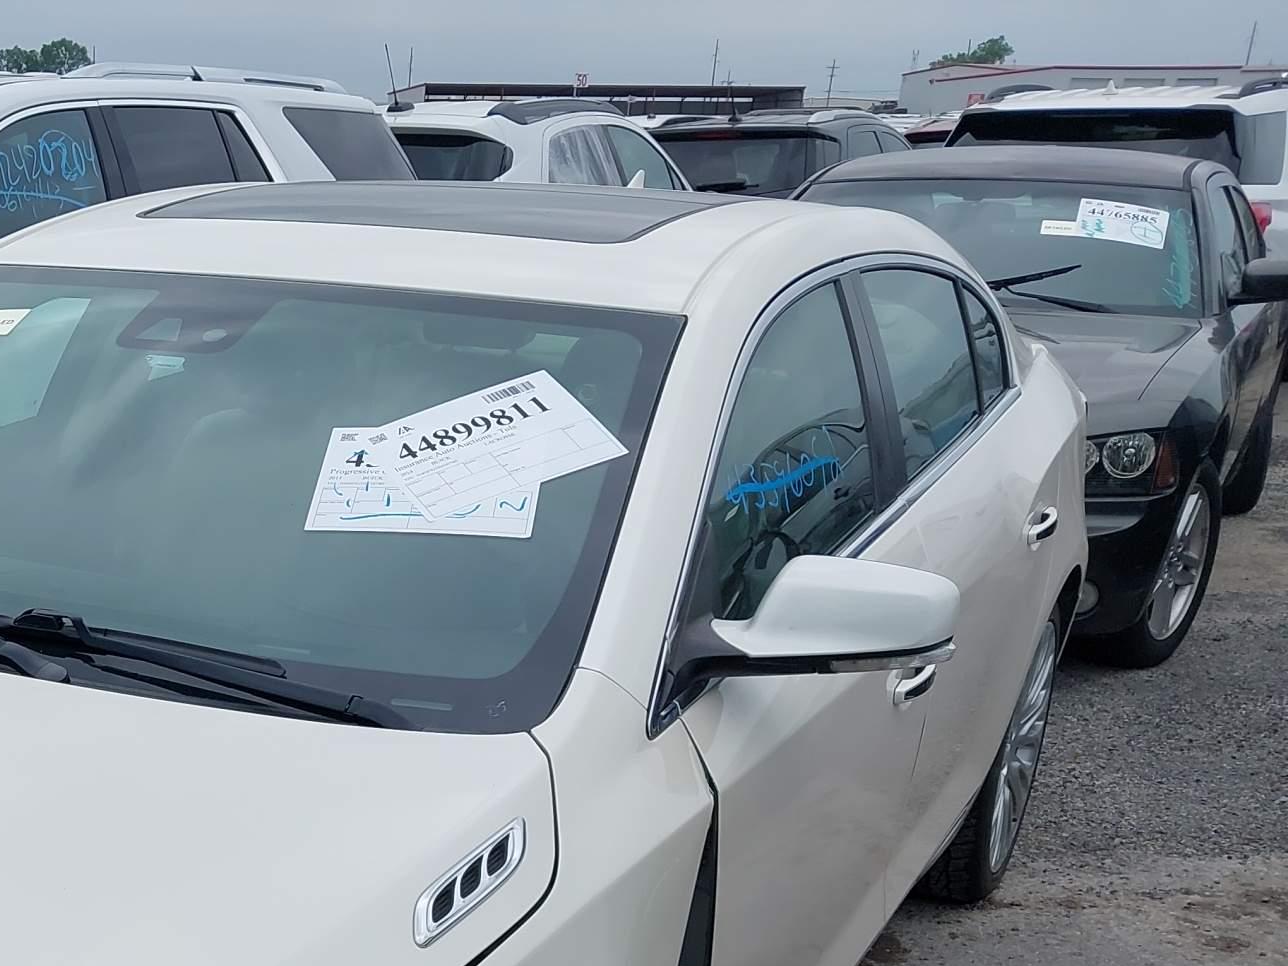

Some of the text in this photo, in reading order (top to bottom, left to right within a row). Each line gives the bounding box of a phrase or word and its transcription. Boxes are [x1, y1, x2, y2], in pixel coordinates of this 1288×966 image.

[576, 73, 588, 87] 50
[399, 396, 551, 459] 44899811
[345, 449, 380, 467] 4
[393, 455, 433, 472] Insurance
[435, 447, 455, 457] Auto
[457, 434, 492, 449] Auctions
